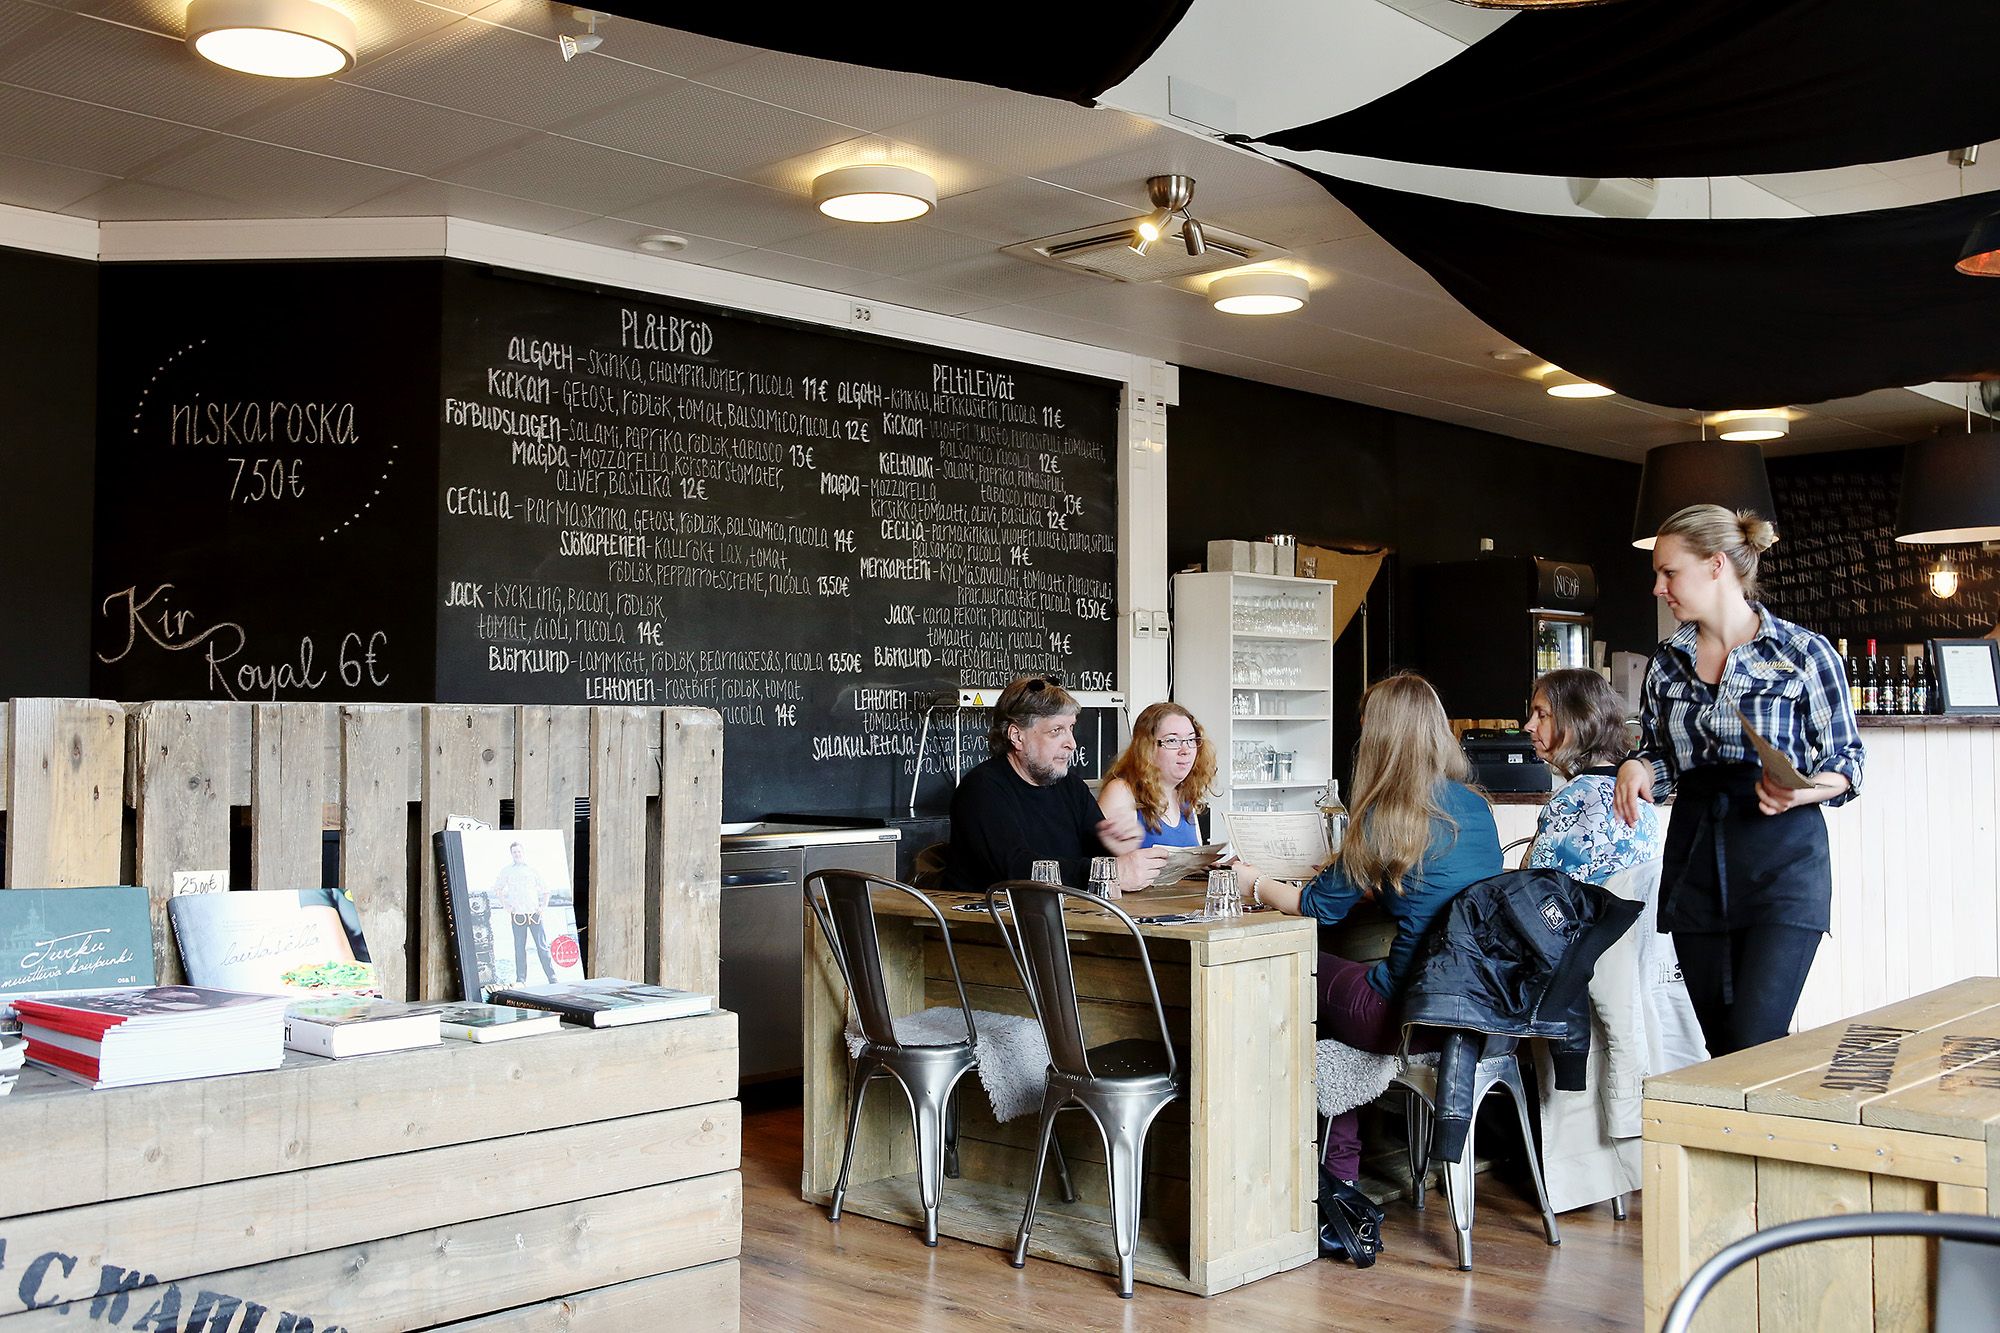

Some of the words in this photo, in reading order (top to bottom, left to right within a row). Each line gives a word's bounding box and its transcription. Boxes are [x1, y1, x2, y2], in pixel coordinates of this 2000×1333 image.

[621, 308, 713, 356] PLÅTBRÖD
[933, 363, 1015, 400] PELTILEIVÄT
[171, 392, 359, 445] niskaroska
[228, 457, 305, 504] 7,50€
[97, 582, 196, 664] Kir
[205, 622, 327, 700] Royal
[339, 630, 390, 688] 6€
[21, 928, 111, 968] Turku
